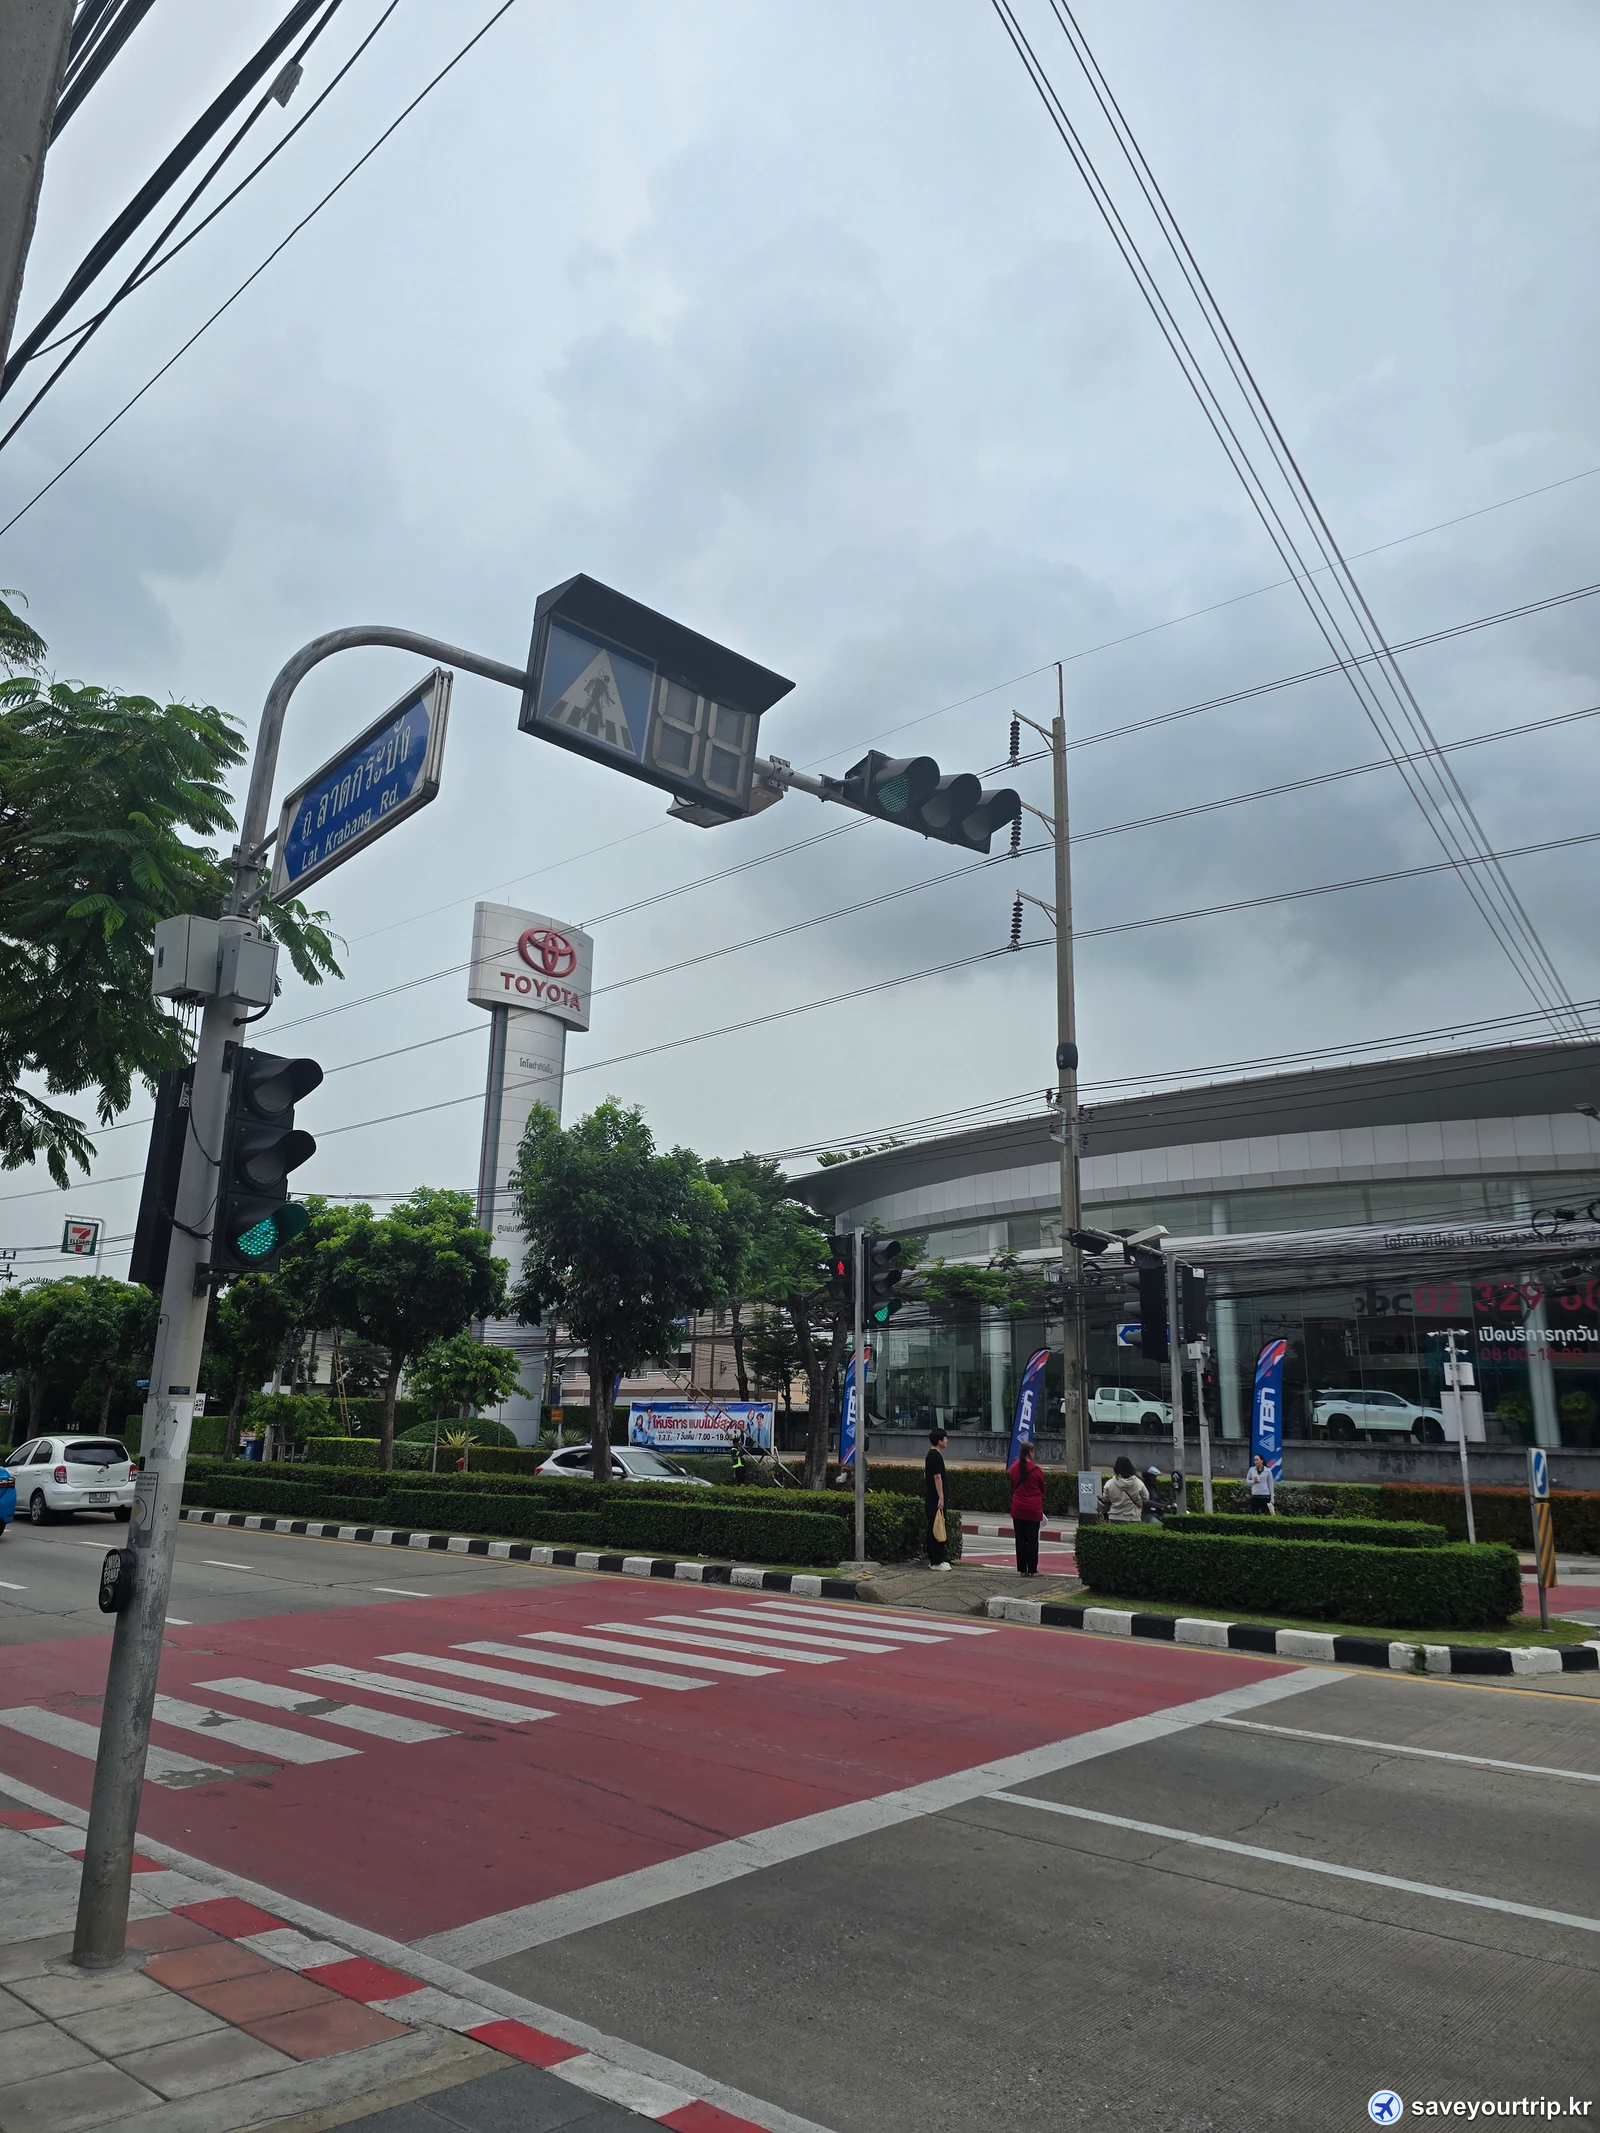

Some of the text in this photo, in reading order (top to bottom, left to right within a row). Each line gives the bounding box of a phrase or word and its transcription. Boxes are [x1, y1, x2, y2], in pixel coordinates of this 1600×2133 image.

[301, 715, 411, 840] ถ. ลาดกระบัง
[301, 783, 399, 871] Lat Krabang Rd.
[500, 971, 581, 1012] TOYOTA
[1415, 1282, 1460, 1313] 02
[1473, 1281, 1543, 1313] 329
[1479, 1324, 1598, 1347] เปิดบริการทุกวัน
[652, 1414, 688, 1430] ให้บริการ
[698, 1433, 711, 1441] 7.00
